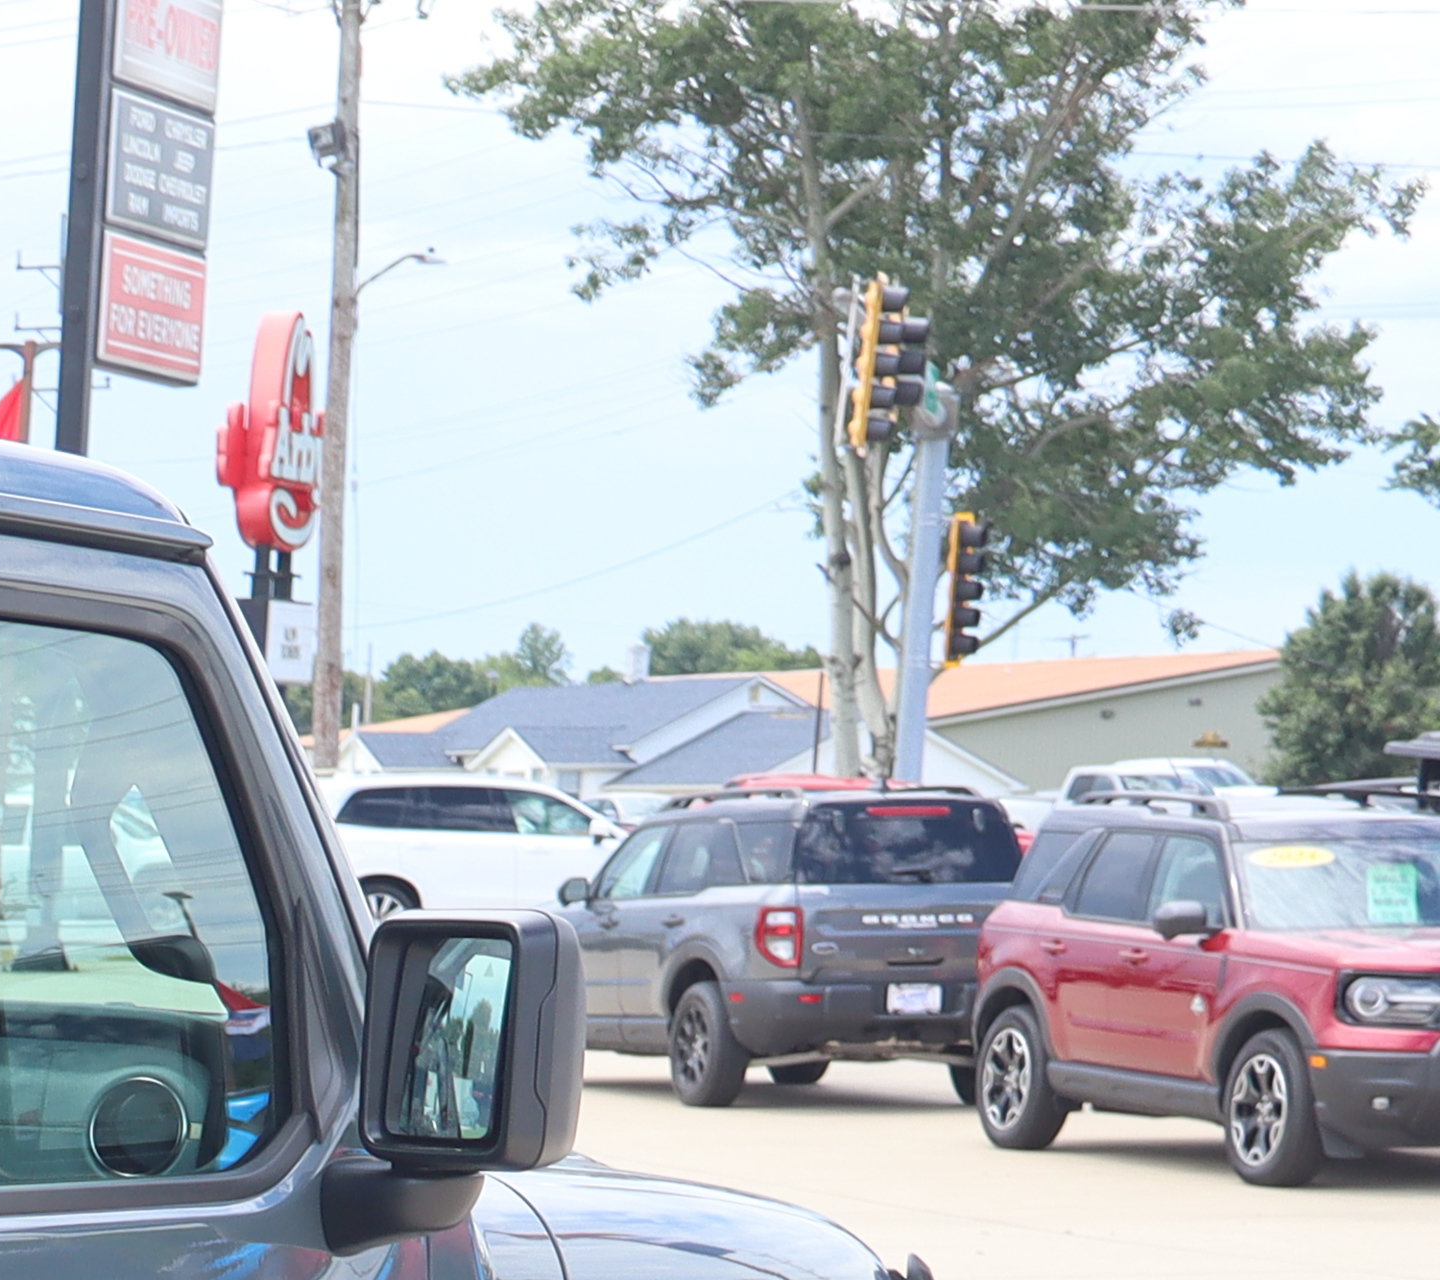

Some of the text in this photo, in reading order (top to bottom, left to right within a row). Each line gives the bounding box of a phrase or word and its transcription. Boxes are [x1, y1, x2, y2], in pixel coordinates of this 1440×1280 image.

[122, 264, 191, 310] SOMETHING
[111, 302, 201, 352] FOR EVERYONE
[861, 913, 974, 925] BRONCO
